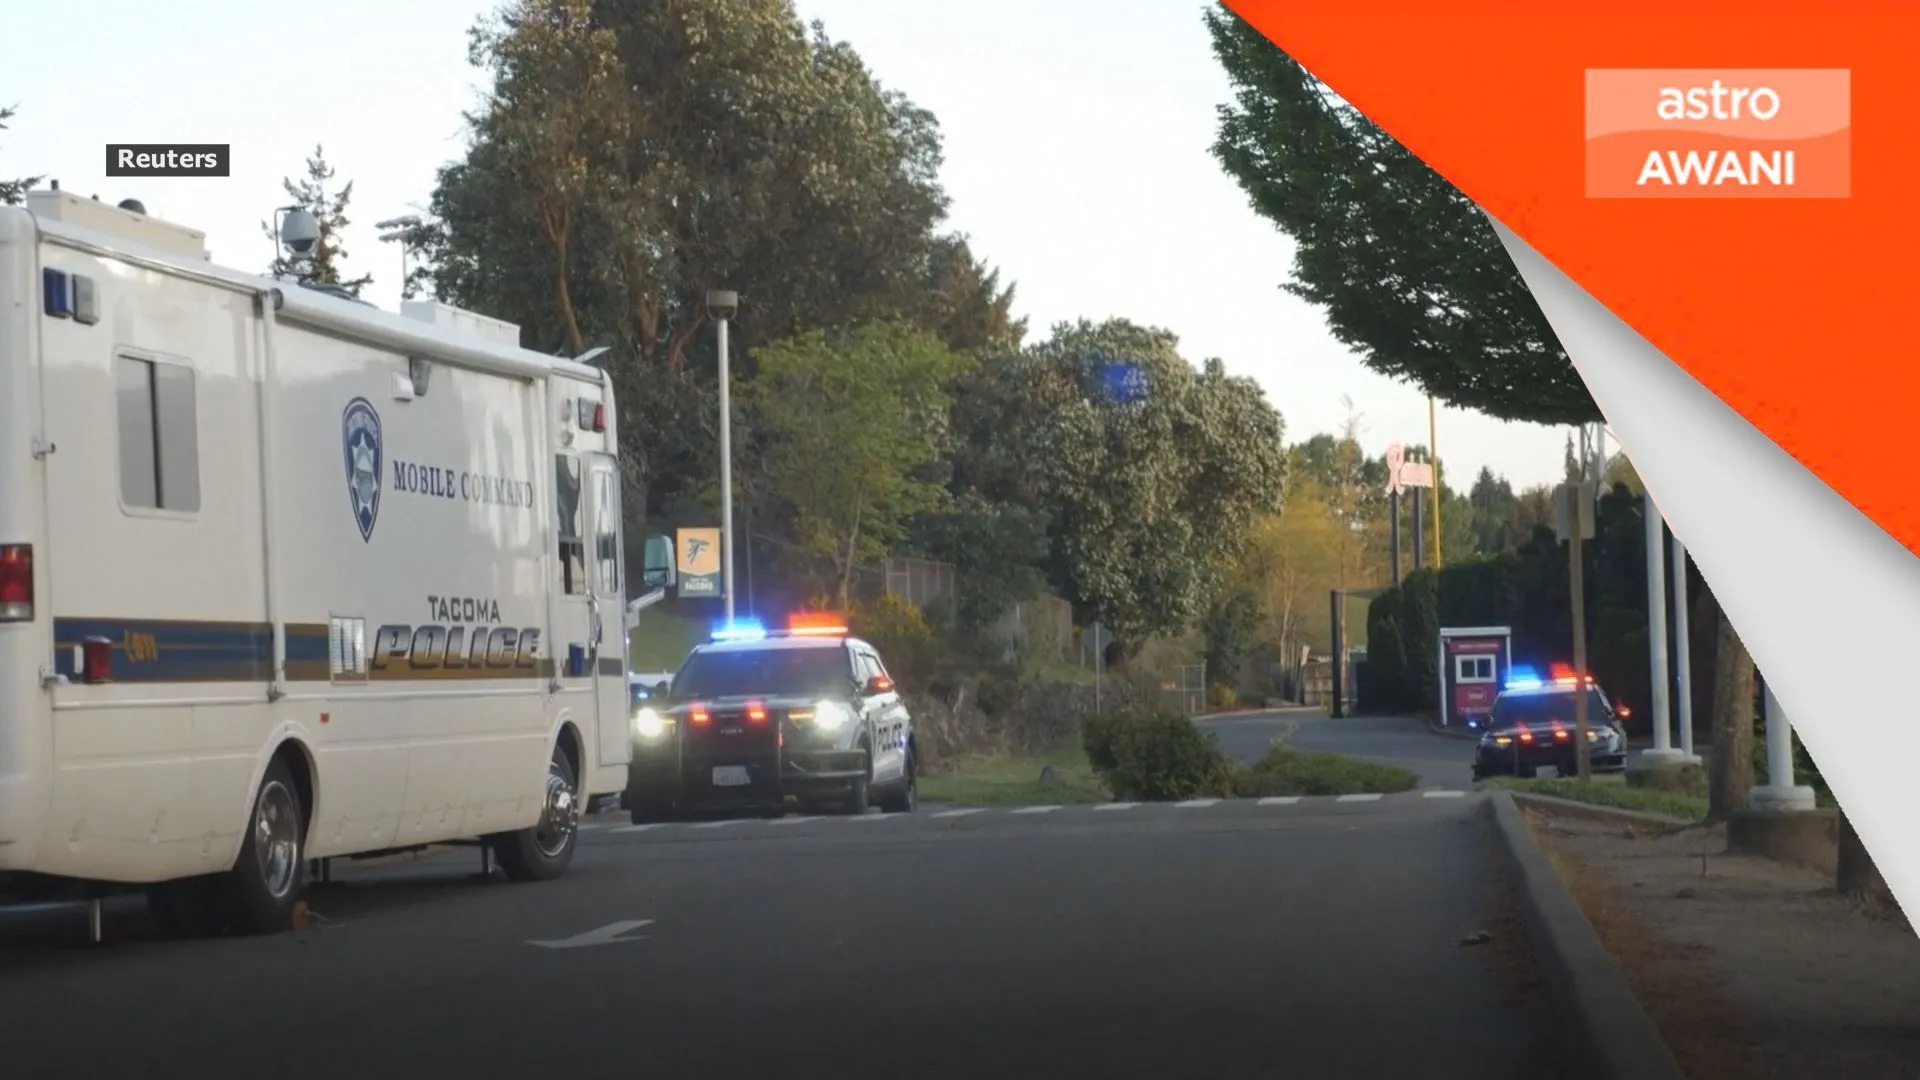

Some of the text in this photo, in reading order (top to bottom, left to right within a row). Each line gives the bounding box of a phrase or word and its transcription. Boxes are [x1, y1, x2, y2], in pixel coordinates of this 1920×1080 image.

[393, 459, 534, 509] MOBILE COMMAND
[427, 595, 502, 625] TACOMA
[371, 624, 541, 671] POLICE
